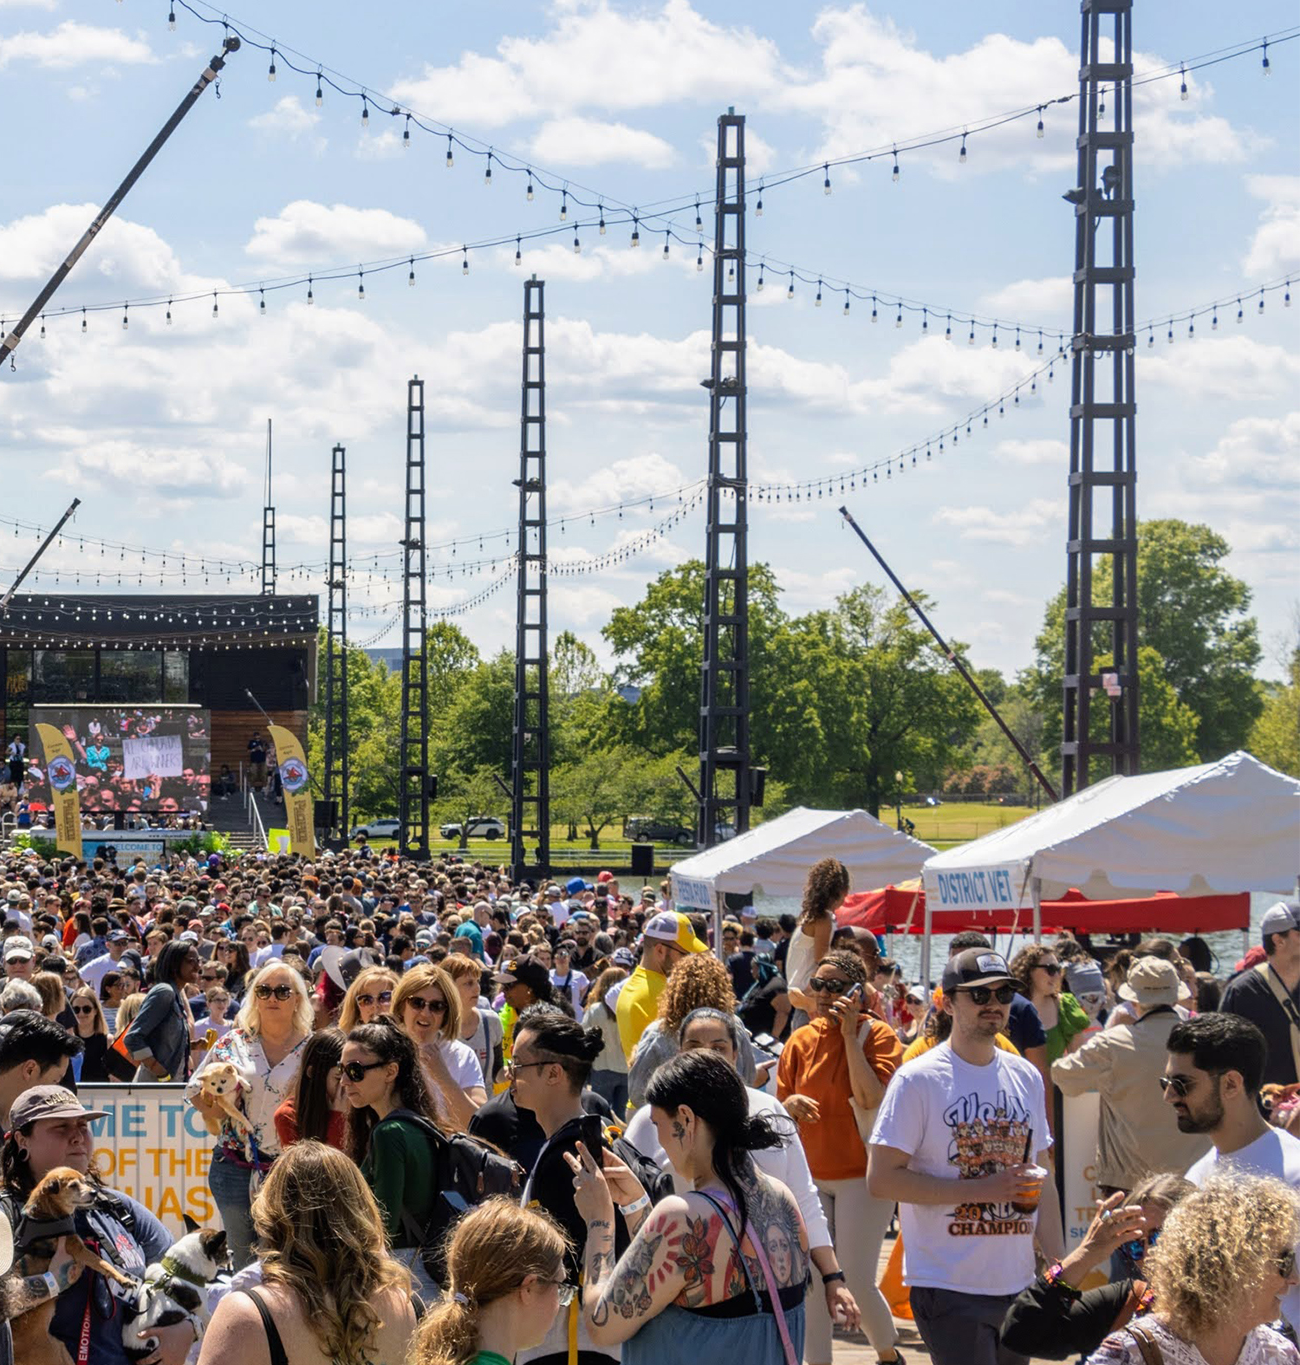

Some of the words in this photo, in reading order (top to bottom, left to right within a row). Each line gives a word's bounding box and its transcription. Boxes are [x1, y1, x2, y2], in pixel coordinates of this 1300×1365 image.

[107, 843, 149, 851] ELCOME
[152, 843, 163, 851] TO
[937, 871, 988, 904] DISTRICT
[987, 870, 1012, 902] VET
[93, 1148, 138, 1178] OF
[145, 1148, 213, 1178] THE
[78, 1307, 90, 1361] EMOTION
